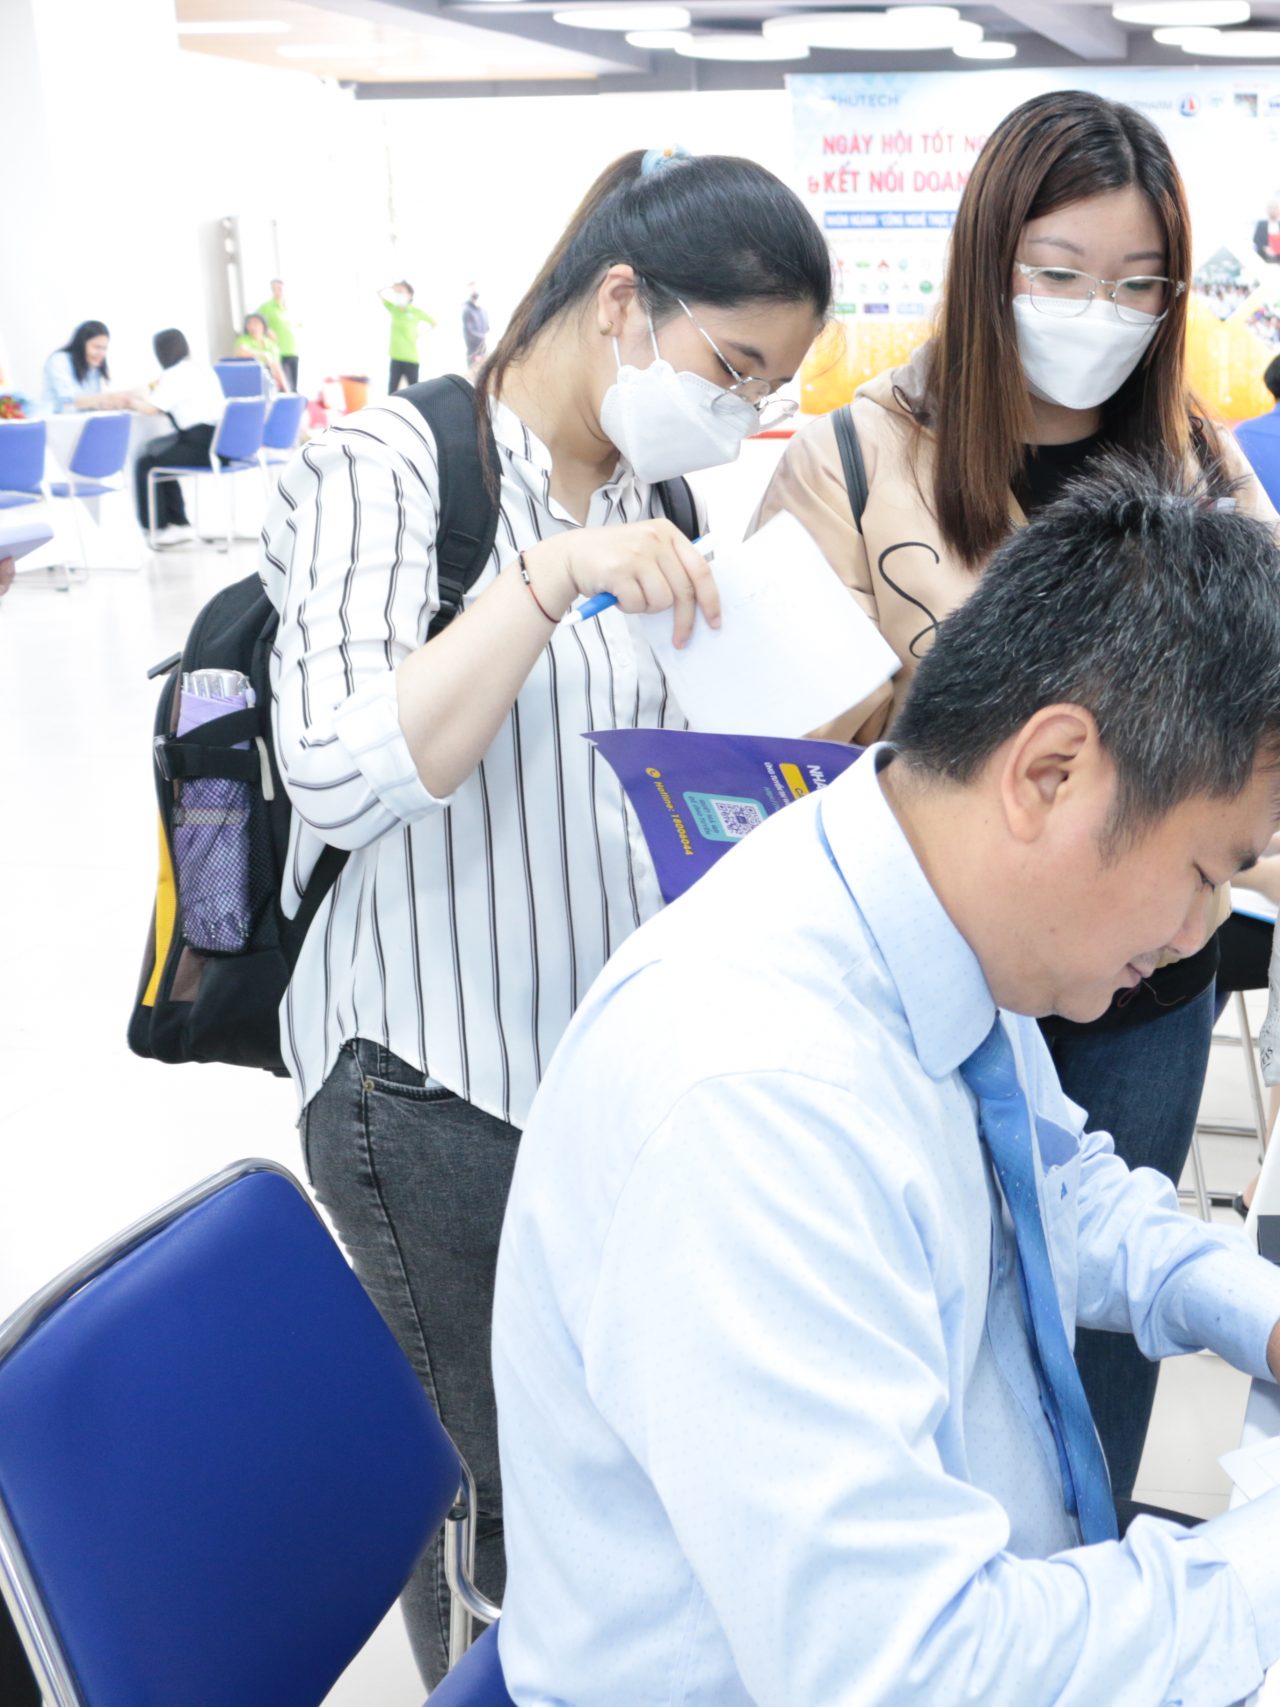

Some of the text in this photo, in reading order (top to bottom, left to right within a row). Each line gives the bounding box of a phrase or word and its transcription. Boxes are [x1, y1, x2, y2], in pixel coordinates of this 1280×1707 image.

[822, 131, 874, 155] NGÀY
[922, 126, 955, 154] TỐT
[824, 160, 860, 192] KẾT
[870, 160, 903, 193] NỐI
[653, 780, 675, 813] Hotline:
